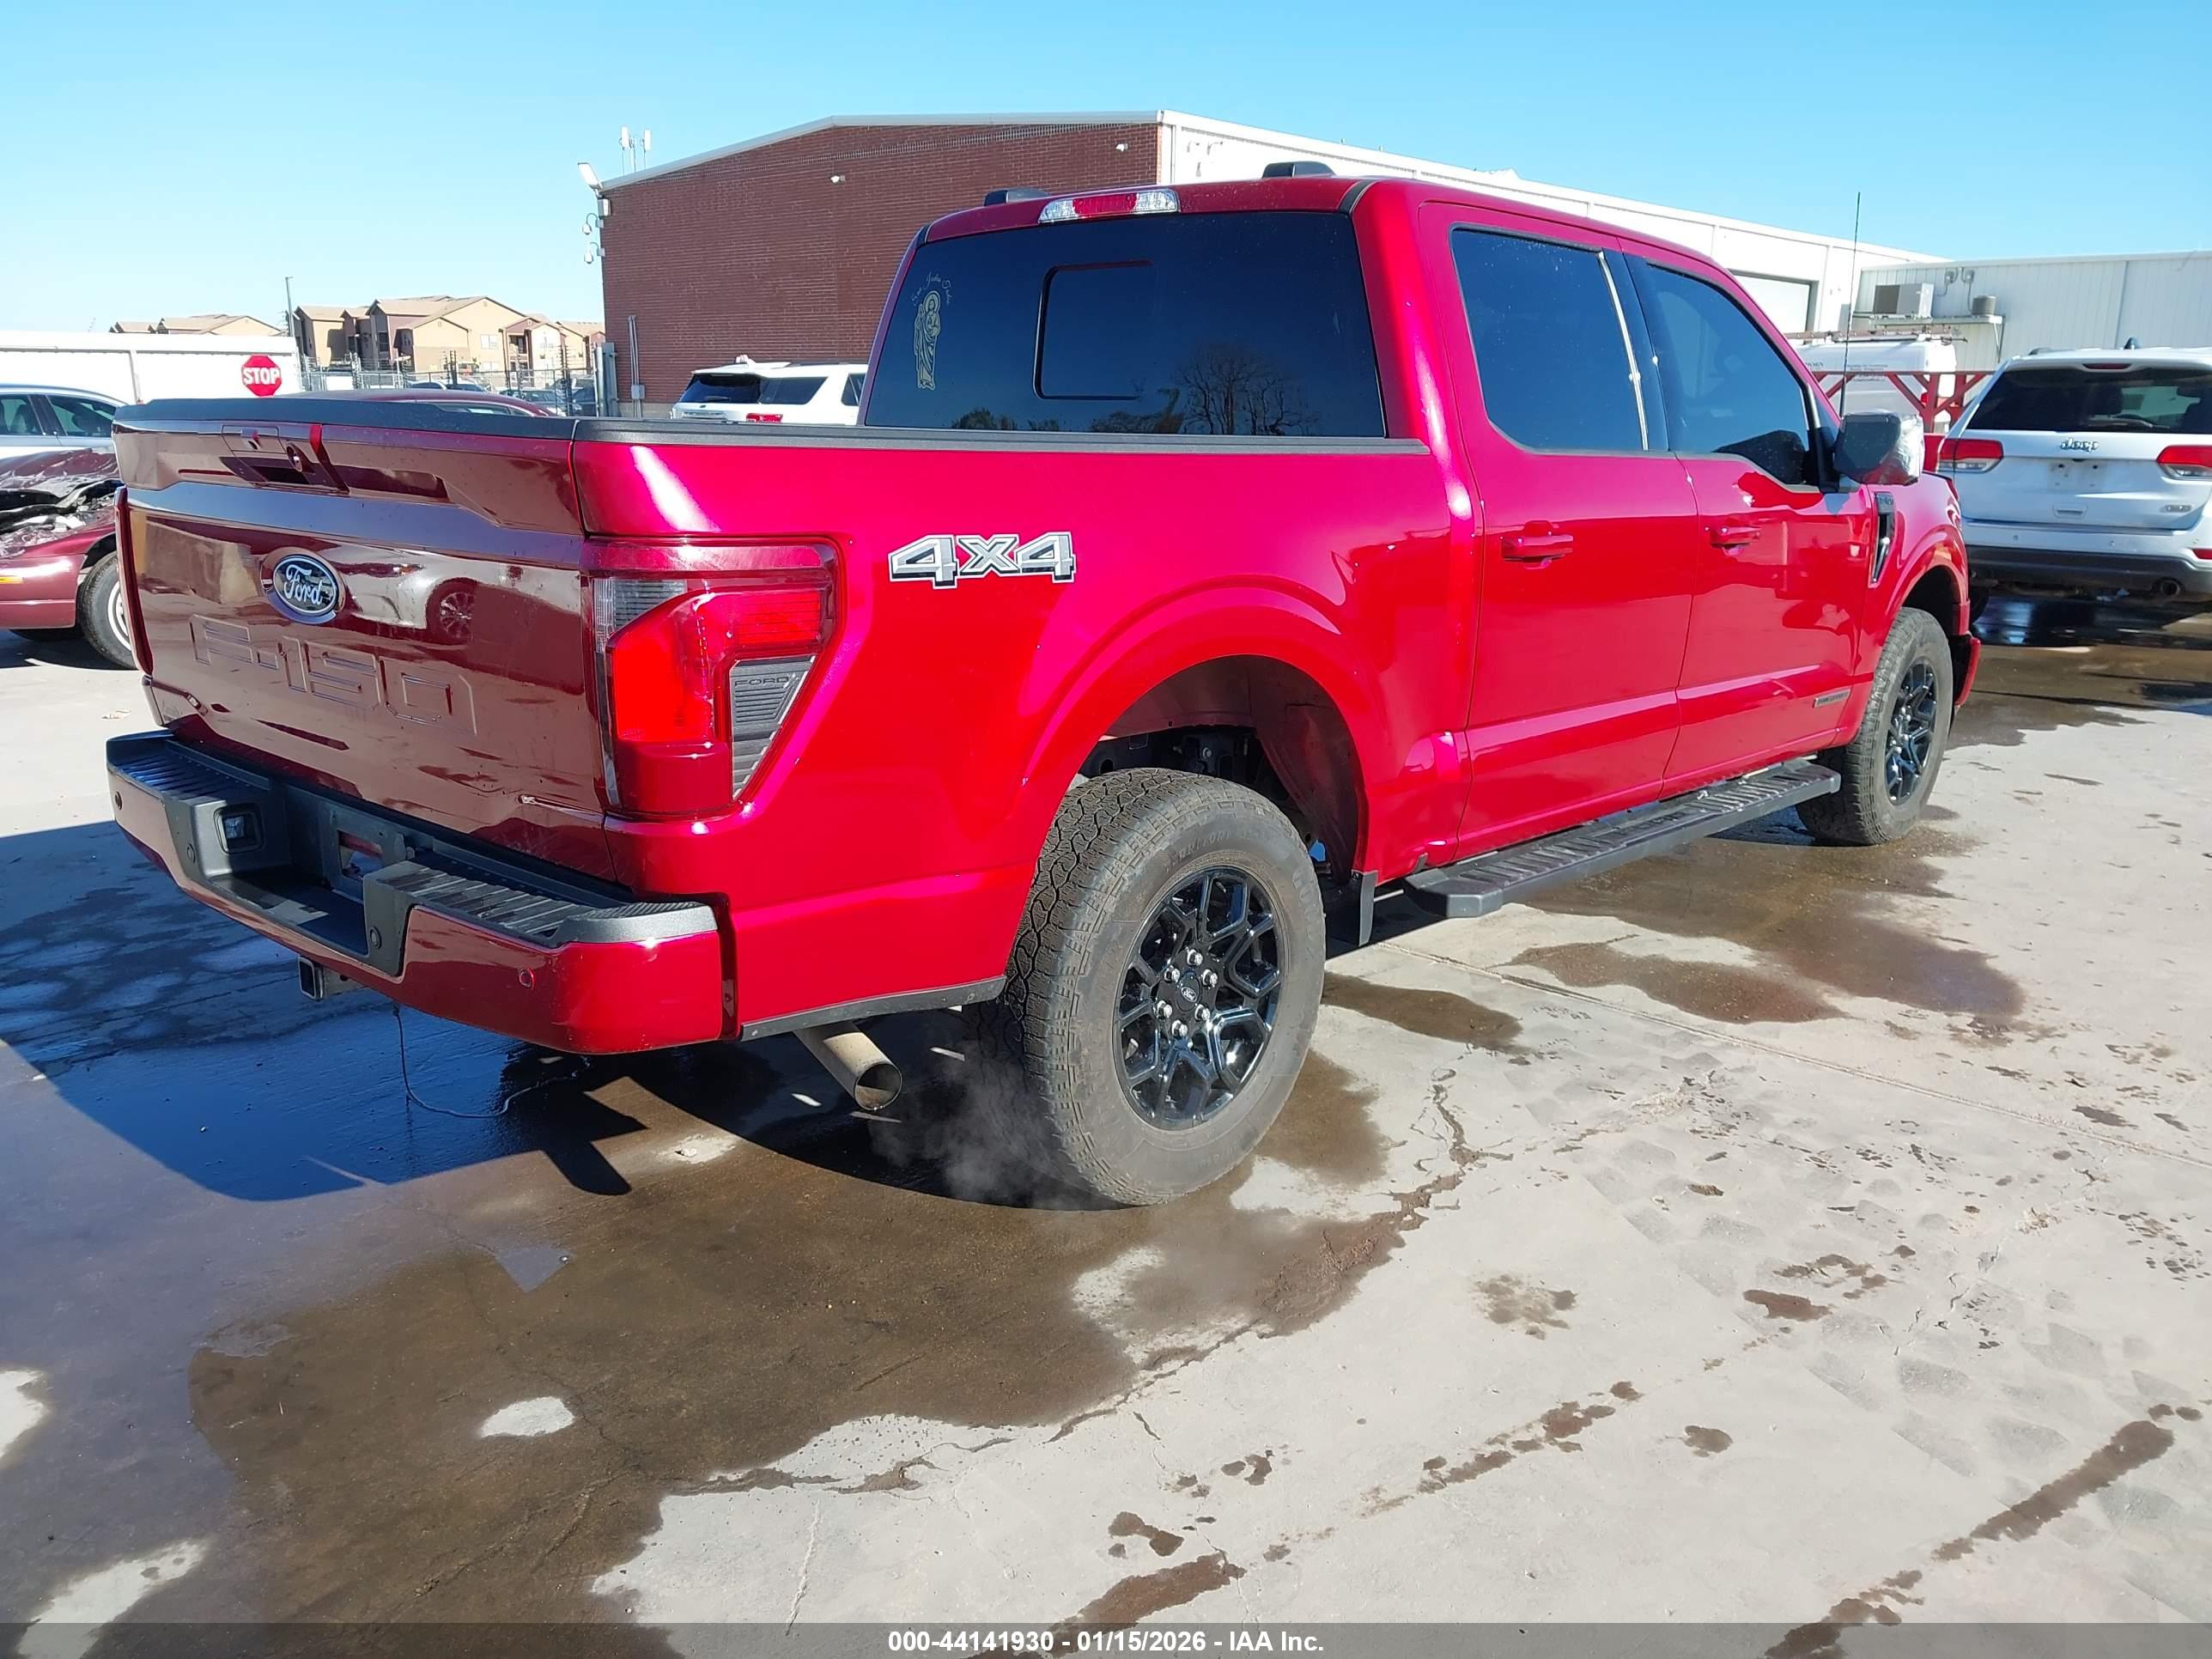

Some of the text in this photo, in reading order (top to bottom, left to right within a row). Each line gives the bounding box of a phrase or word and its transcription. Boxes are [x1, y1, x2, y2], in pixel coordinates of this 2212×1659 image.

[243, 367, 281, 385] STOP
[2060, 436, 2100, 453] Jeep
[283, 563, 325, 605] Ford
[188, 614, 477, 736] F-150
[734, 676, 789, 687] FORD
